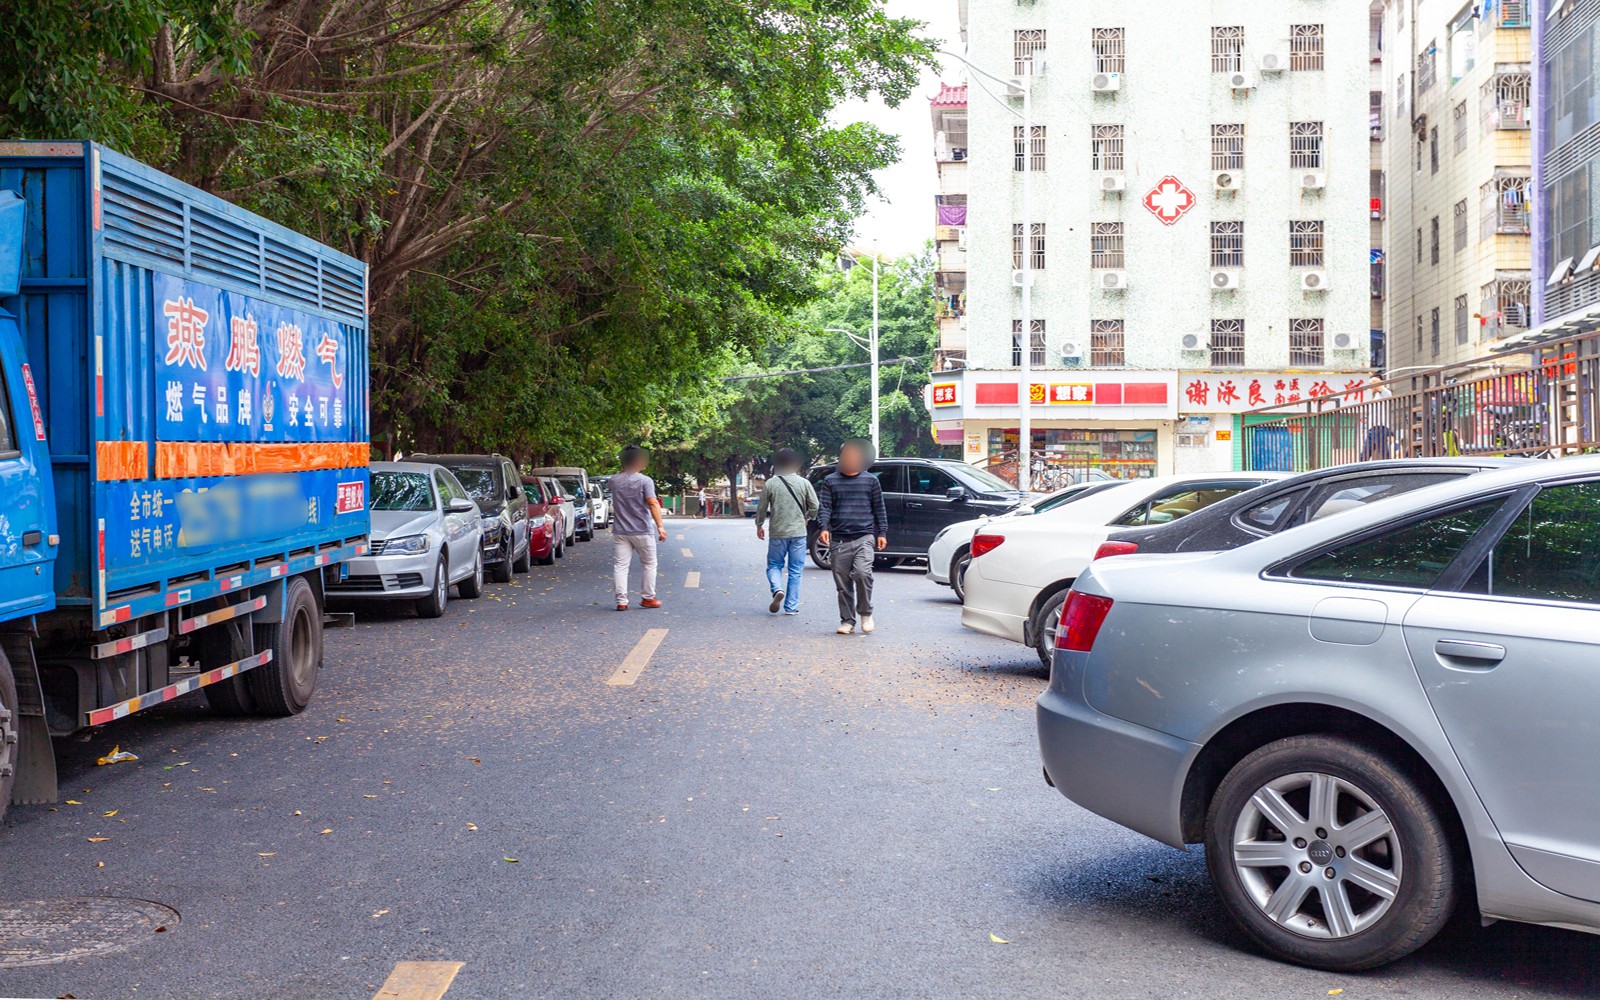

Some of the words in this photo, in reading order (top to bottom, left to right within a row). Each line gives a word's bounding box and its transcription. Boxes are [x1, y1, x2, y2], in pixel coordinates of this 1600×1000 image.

[163, 295, 344, 390] 燕鹏燃气
[935, 387, 954, 401] 想家
[1056, 385, 1087, 401] 想家
[1185, 379, 1266, 407] 谢泳良
[1308, 379, 1365, 405] 诊所
[1274, 378, 1300, 391] 西医
[165, 381, 252, 426] 燃气品牌
[288, 393, 344, 430] 安全可靠
[129, 489, 174, 520] 全市统一
[129, 523, 174, 558] 送气电话
